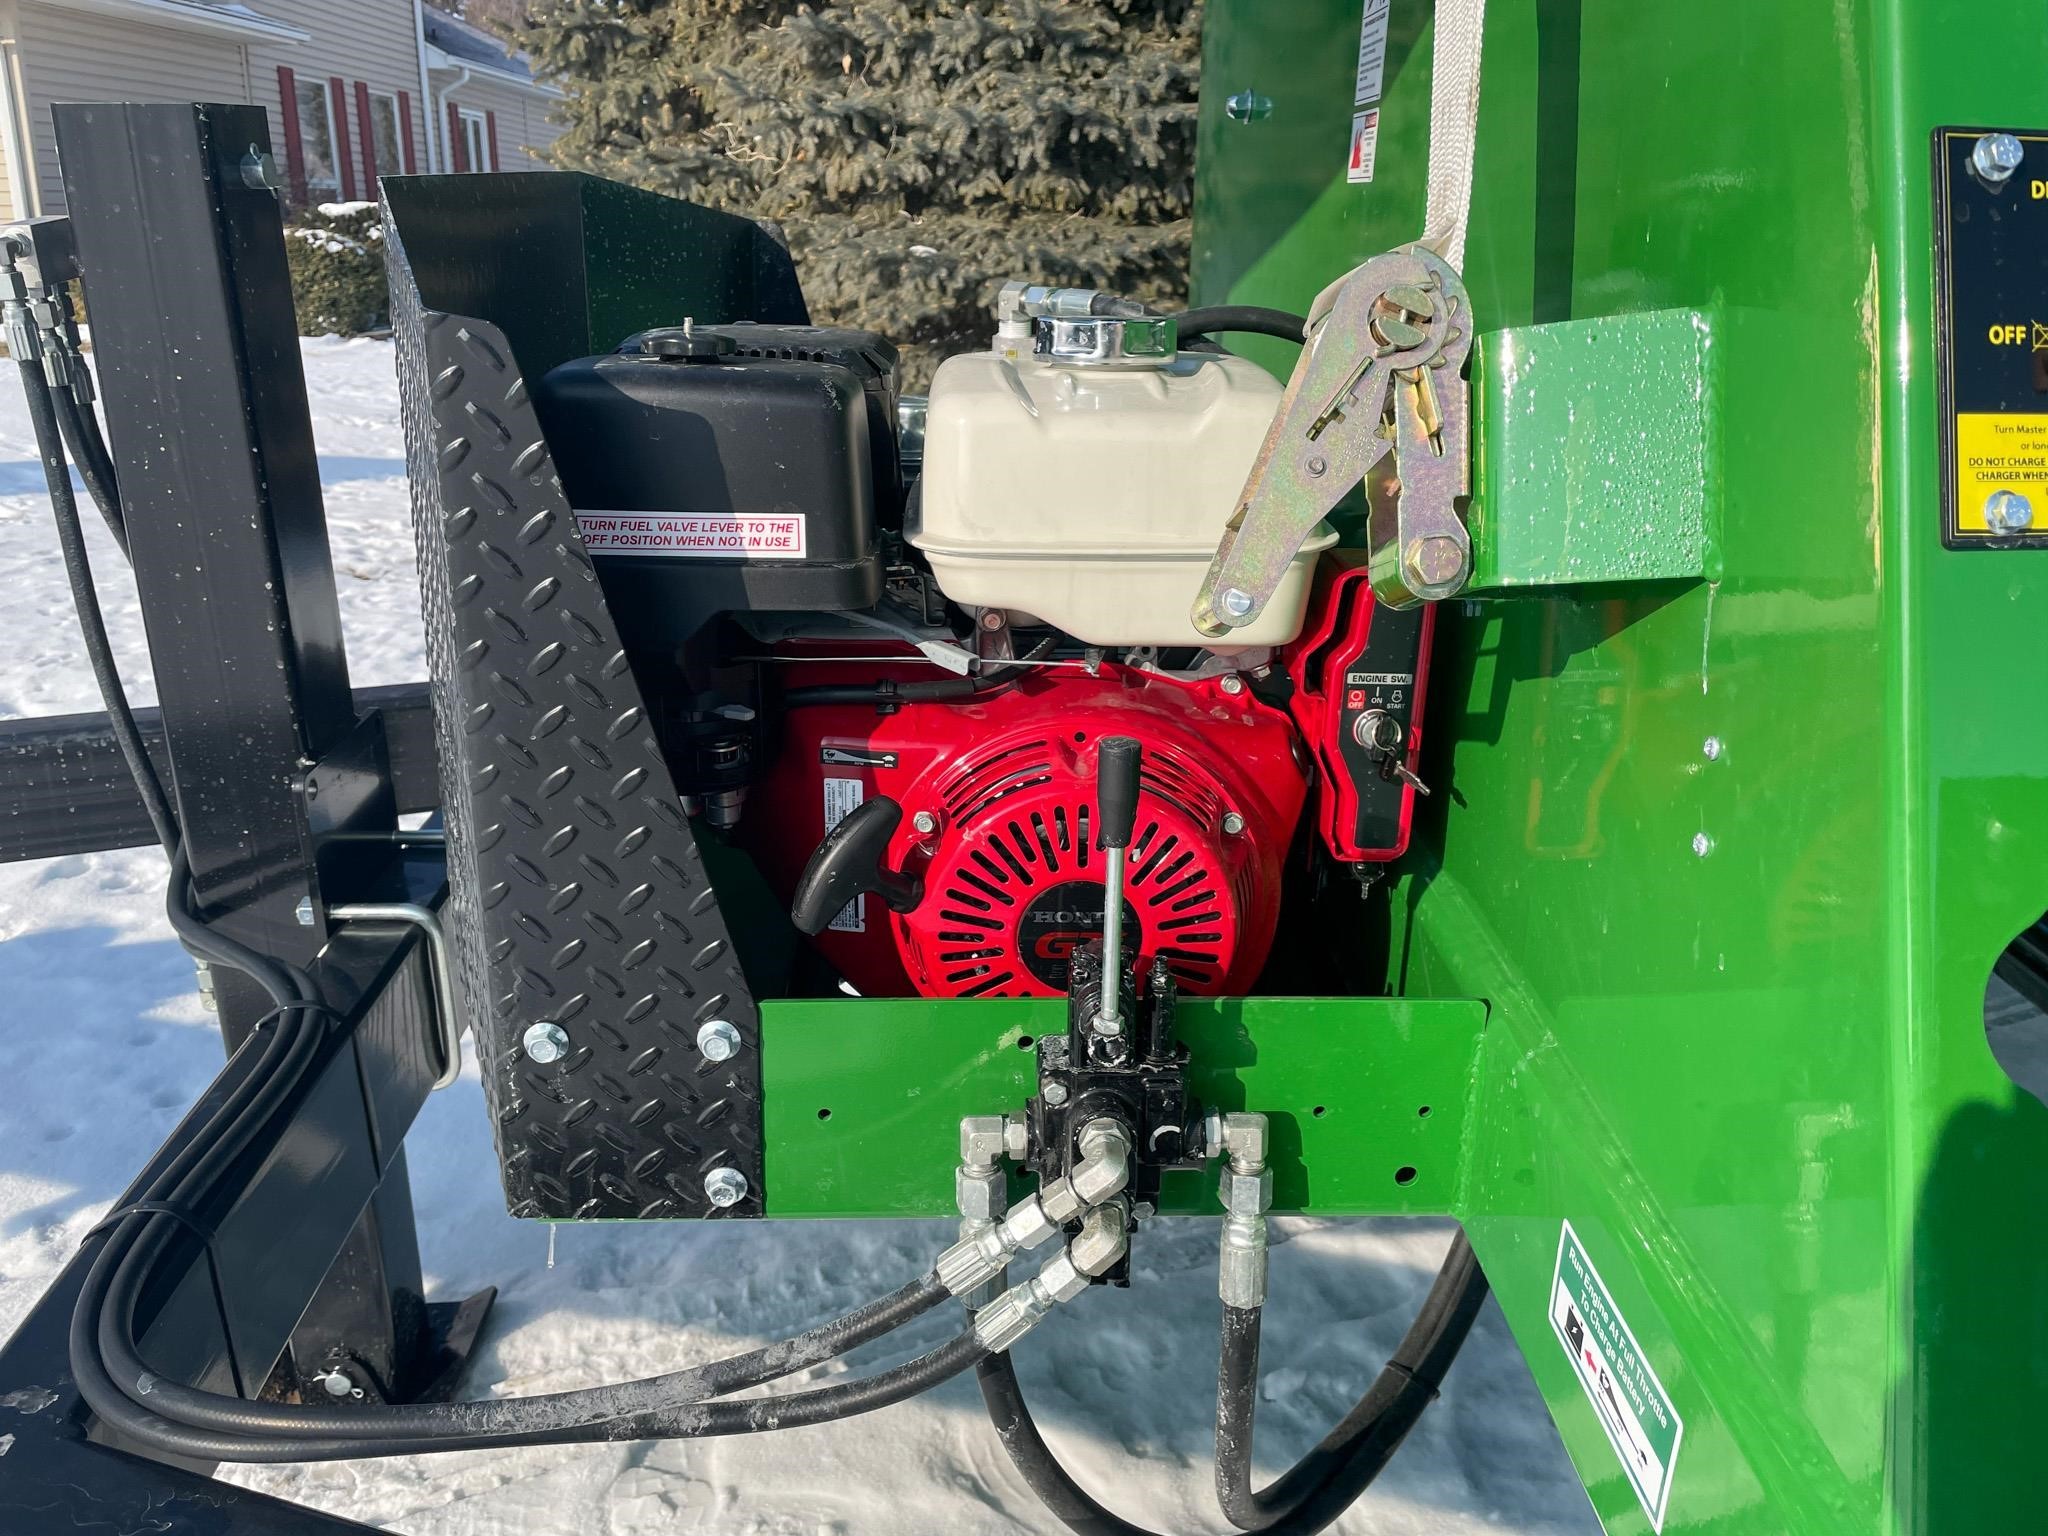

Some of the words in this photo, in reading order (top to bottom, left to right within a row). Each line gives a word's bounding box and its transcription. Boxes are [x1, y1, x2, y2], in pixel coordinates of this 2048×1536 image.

[2032, 180, 2048, 199] D
[1988, 325, 2026, 345] OFF
[1994, 425, 2014, 433] Turn
[2016, 425, 2047, 433] Master
[1968, 457, 1983, 466] DO
[1986, 457, 2005, 466] NOT
[2008, 457, 2046, 466] CHARGE
[1976, 471, 2021, 480] CHARGER
[581, 520, 617, 531] TURN
[620, 521, 653, 531] FUEL
[657, 521, 698, 532] VALVE
[701, 522, 744, 533] LEVER
[748, 523, 765, 533] TO
[769, 523, 794, 533] THE
[582, 534, 608, 544] OFF
[611, 534, 672, 545] POSITION
[676, 535, 715, 546] WHEN
[718, 536, 746, 546] NOT
[748, 537, 761, 546] IN
[765, 537, 791, 547] USE
[1352, 675, 1388, 683] ENGINE
[1390, 675, 1408, 683] SW.
[1568, 1246, 1584, 1279] Run
[1583, 1272, 1609, 1324] Engine
[1608, 1321, 1619, 1342] At
[1618, 1336, 1635, 1370] Full
[1635, 1364, 1667, 1429] Throttle
[1580, 1290, 1590, 1313] To
[1590, 1309, 1616, 1362] Charge
[1616, 1357, 1645, 1416] Battery
